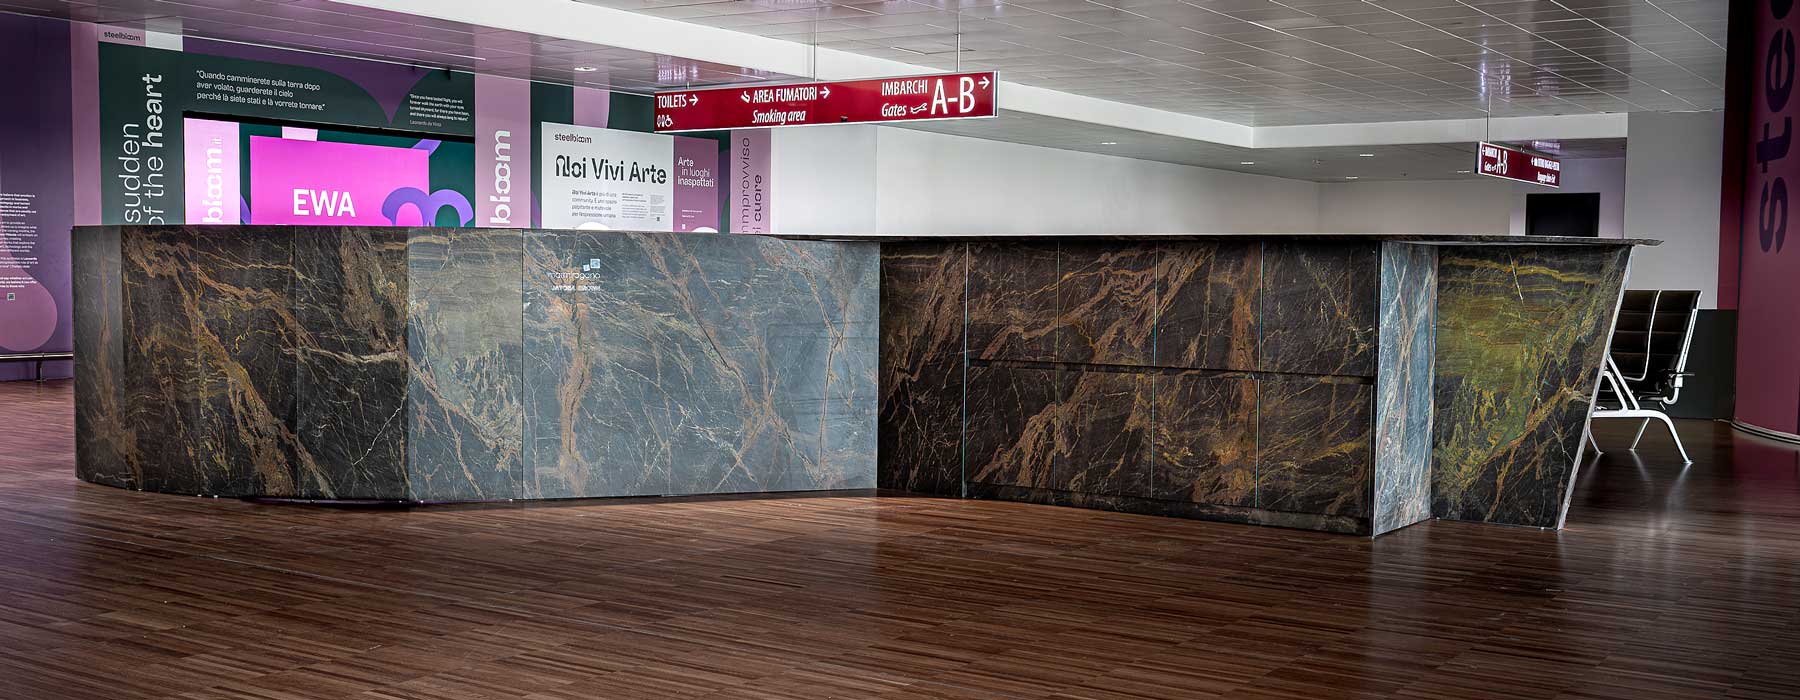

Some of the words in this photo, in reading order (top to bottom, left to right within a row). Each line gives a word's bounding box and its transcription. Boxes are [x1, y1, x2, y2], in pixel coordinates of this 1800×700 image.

[196, 81, 212, 89] aver
[236, 86, 273, 96] guarderete
[278, 90, 294, 98] cielo
[226, 74, 270, 86] camminerete
[271, 79, 287, 88] sulla
[287, 81, 303, 89] terra
[304, 83, 320, 91] dopo
[881, 79, 929, 96] IMBARCHI
[246, 97, 261, 105] stati
[274, 100, 298, 109] vorrete
[657, 94, 687, 108] TOILETS
[753, 89, 775, 103] AREA
[776, 86, 817, 101] FUMATORI
[930, 76, 976, 115] A-B
[142, 74, 163, 148] heart
[752, 109, 788, 125] Smoking
[788, 110, 806, 122] area
[881, 103, 907, 117] Gates
[1757, 0, 1796, 254] ste
[554, 133, 592, 144] steelbloom
[678, 156, 694, 167] Arte
[118, 123, 141, 223] sudden
[143, 156, 164, 198] the
[489, 130, 511, 224] bloom
[591, 157, 624, 181] Vivi
[629, 161, 667, 184] Arte
[682, 166, 689, 176] in
[690, 167, 711, 178] luoghi
[293, 188, 356, 218] EWA
[754, 174, 762, 222] cuore
